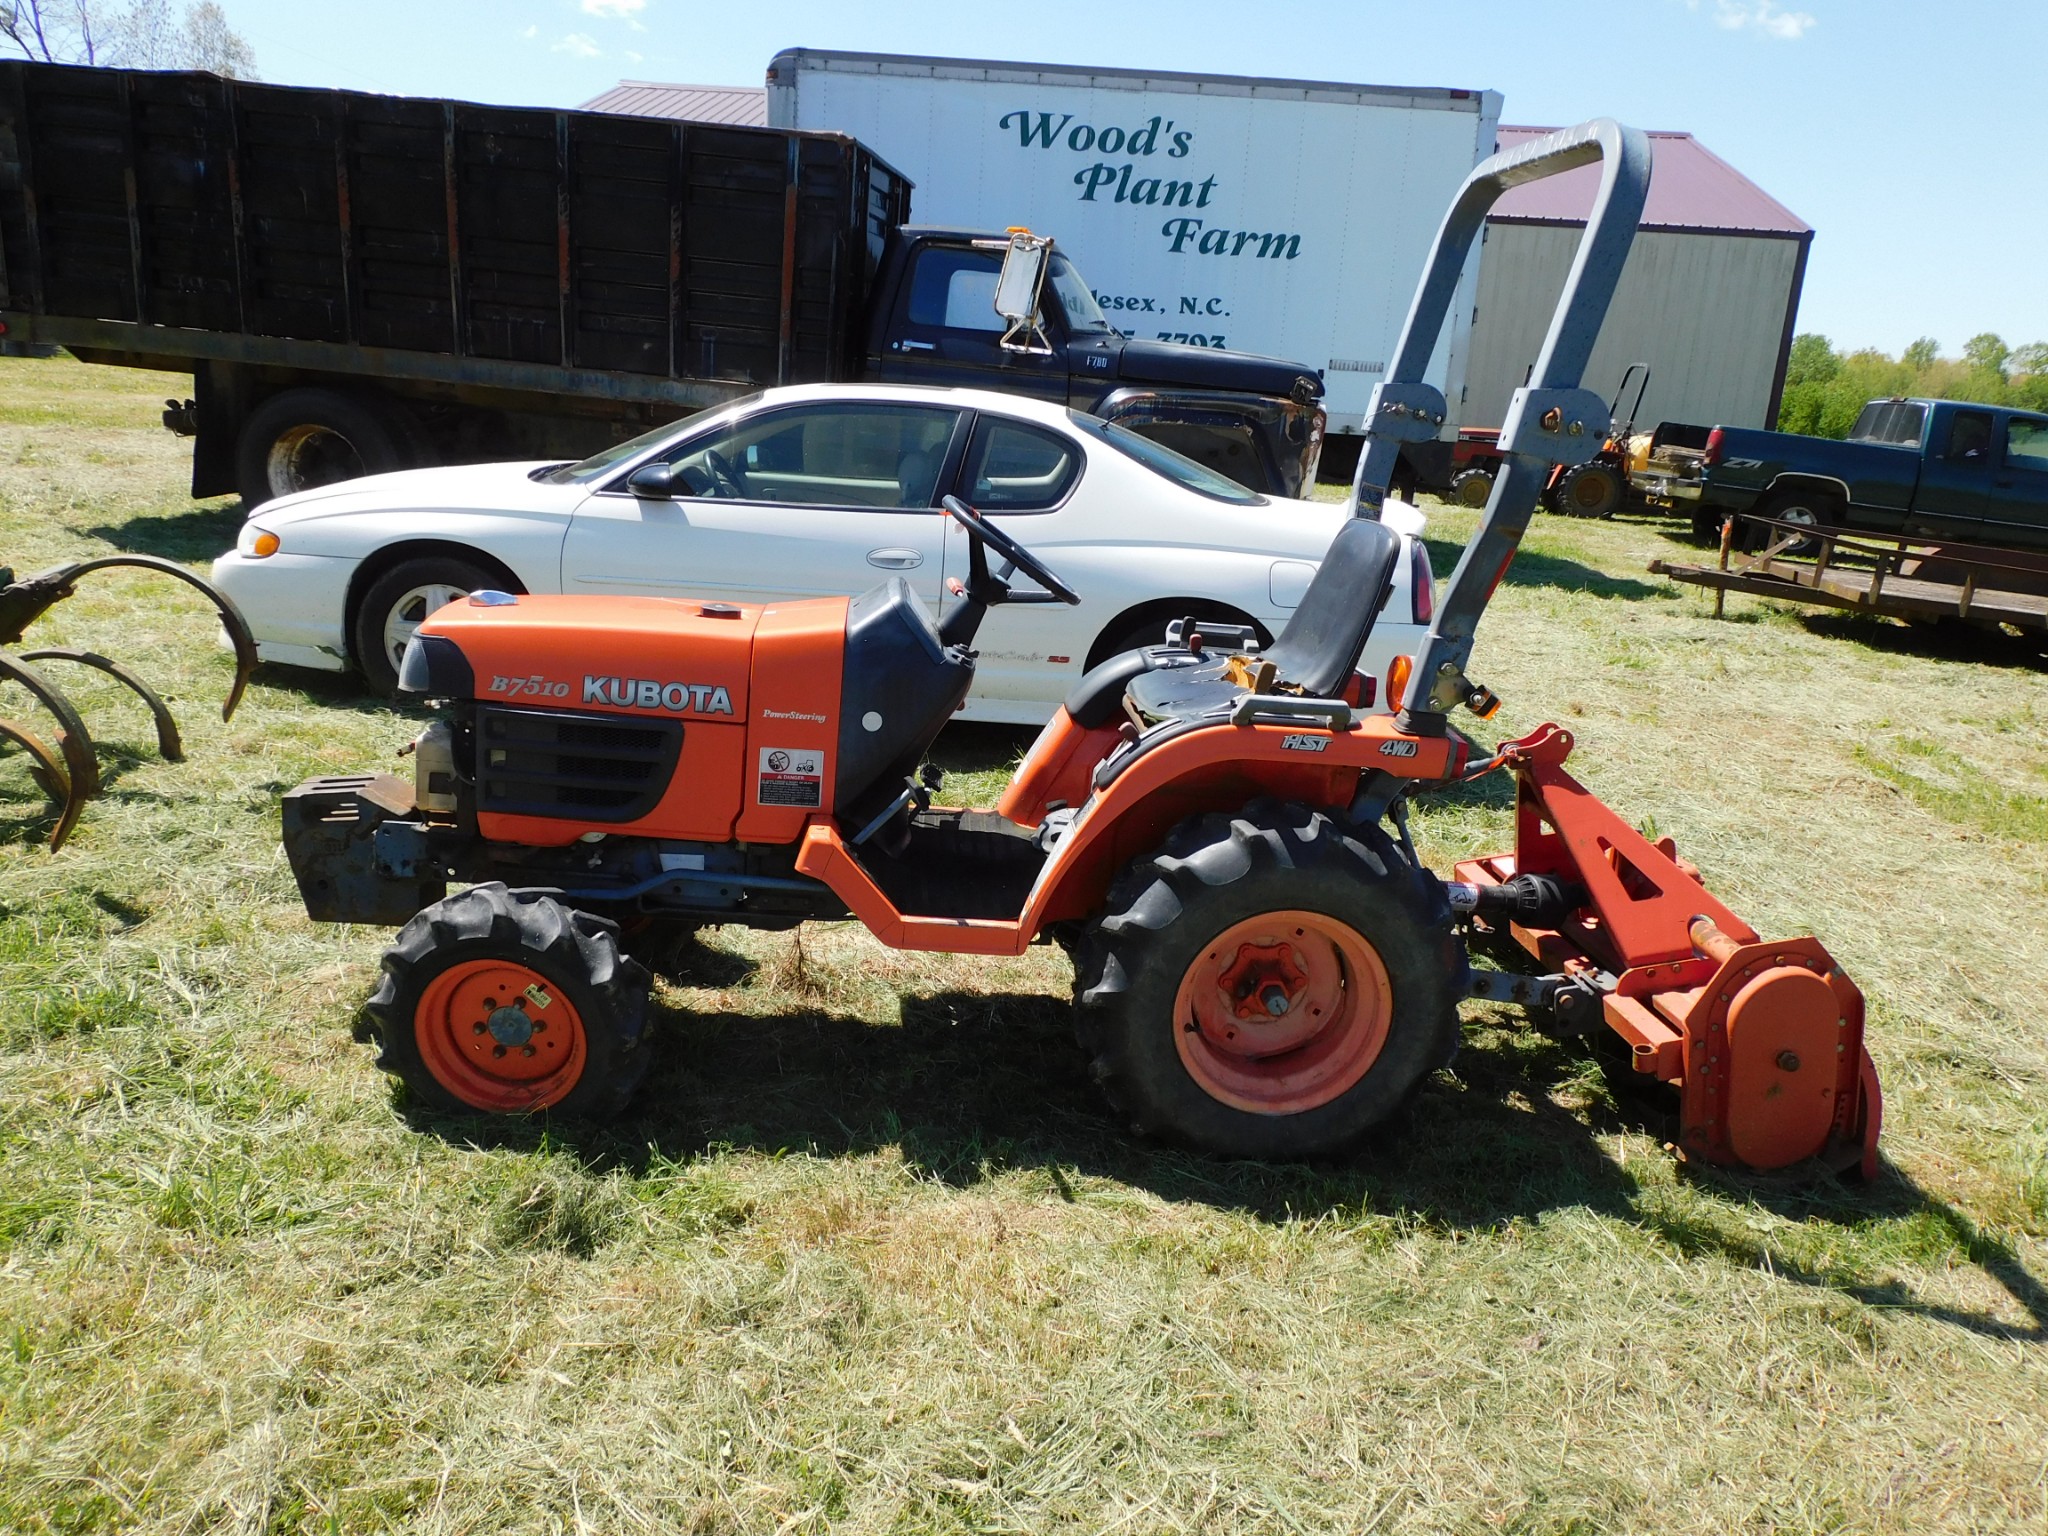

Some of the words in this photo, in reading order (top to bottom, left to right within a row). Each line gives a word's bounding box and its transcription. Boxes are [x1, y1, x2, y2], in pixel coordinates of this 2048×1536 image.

[998, 110, 1193, 159] Wood's
[1073, 162, 1219, 209] Plant
[1161, 217, 1302, 260] Farm
[1178, 296, 1231, 317] N.C.
[1721, 456, 1764, 469] Z71
[487, 674, 570, 698] B7510
[582, 674, 734, 715] KUBOTA
[763, 708, 827, 724] PowerSteering
[1378, 739, 1418, 757] 4WD
